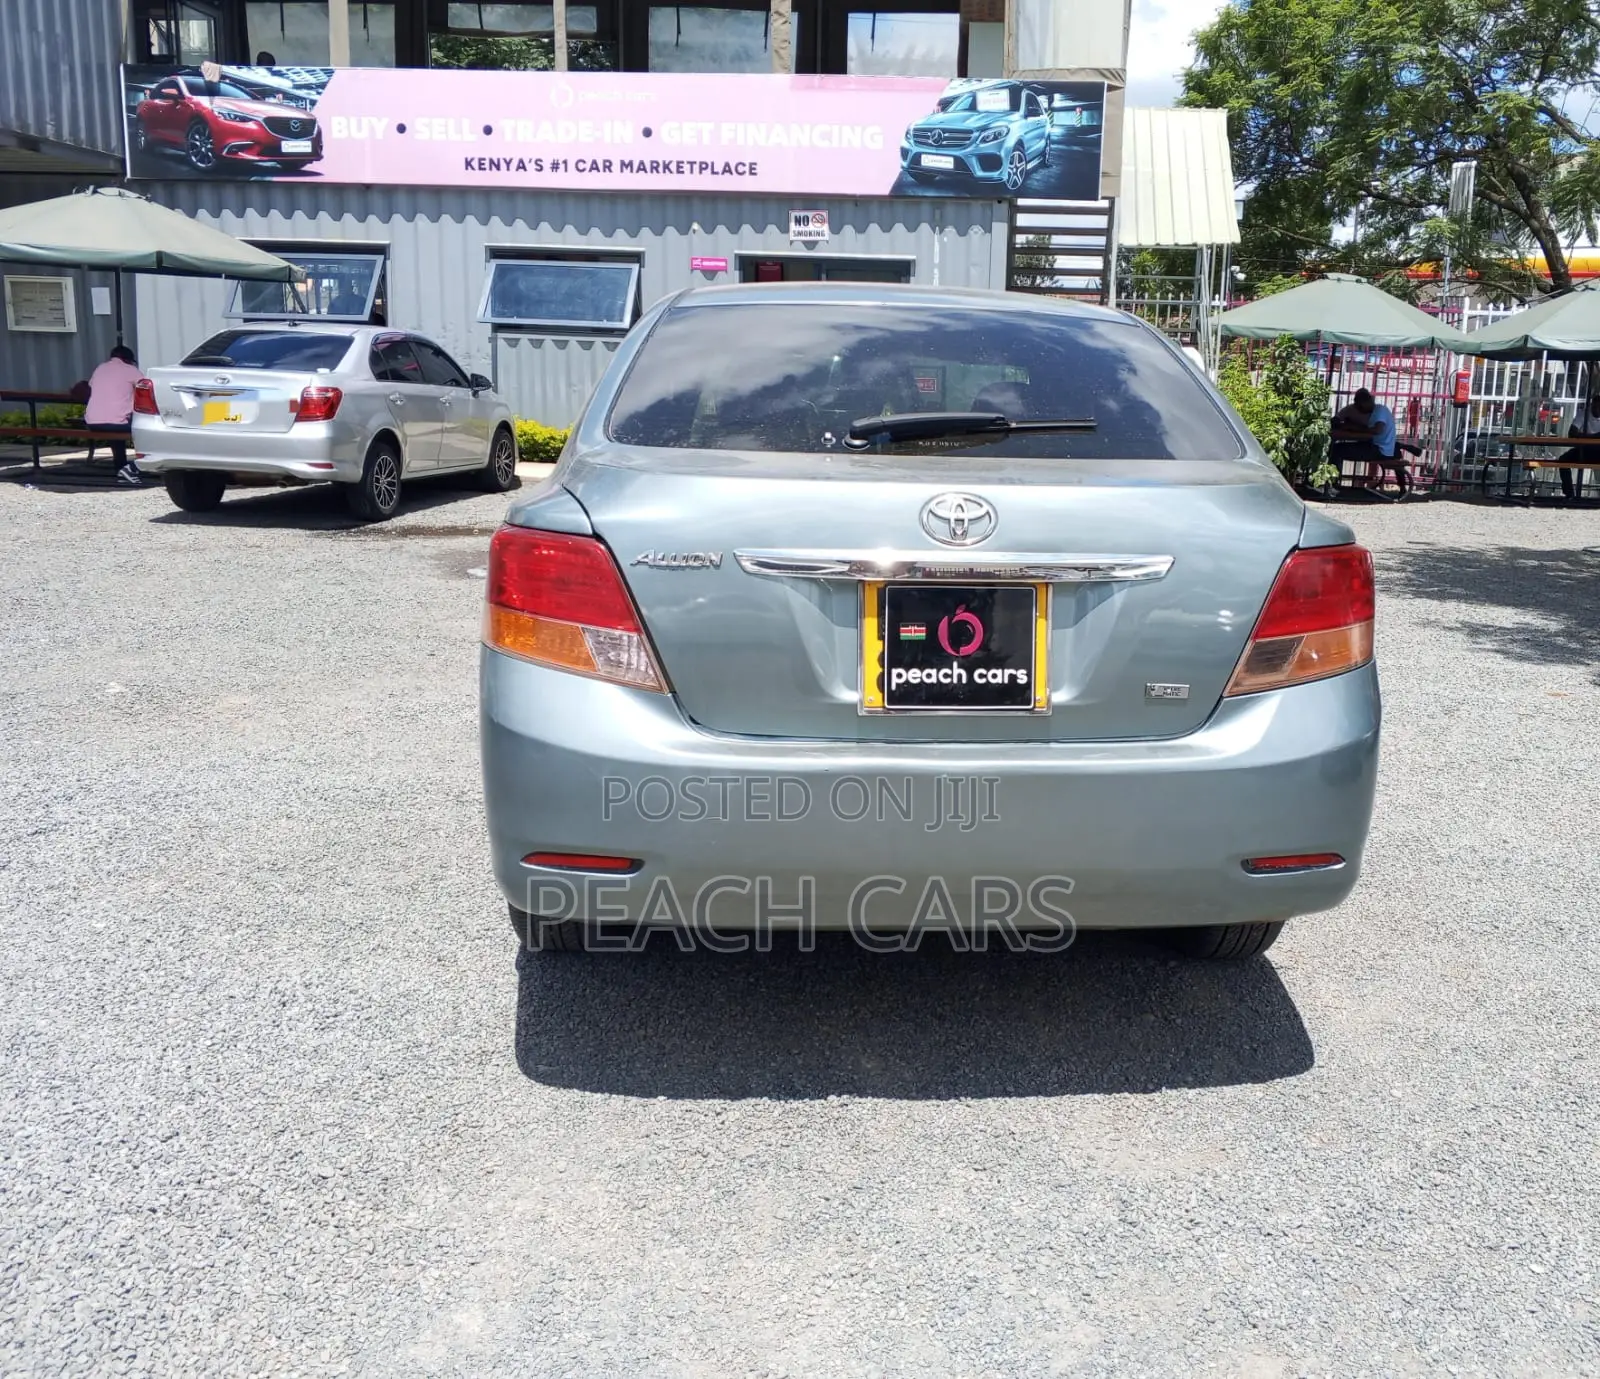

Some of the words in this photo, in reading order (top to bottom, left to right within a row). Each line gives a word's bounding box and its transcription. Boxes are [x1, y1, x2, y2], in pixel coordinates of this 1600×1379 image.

[331, 116, 389, 140] BUY
[414, 117, 477, 142] SELL
[502, 119, 633, 145] TRADE-IN
[660, 121, 715, 146] GET
[721, 123, 884, 149] FINANCING
[464, 157, 544, 173] KENYA'S
[550, 159, 568, 173] #1
[575, 159, 613, 173] CAR
[620, 159, 758, 176] MARKETPLACE
[794, 215, 810, 227] NO
[793, 230, 826, 238] SMOKING
[630, 549, 723, 568] ALLION
[891, 661, 967, 691] peach
[973, 667, 1028, 685] cars
